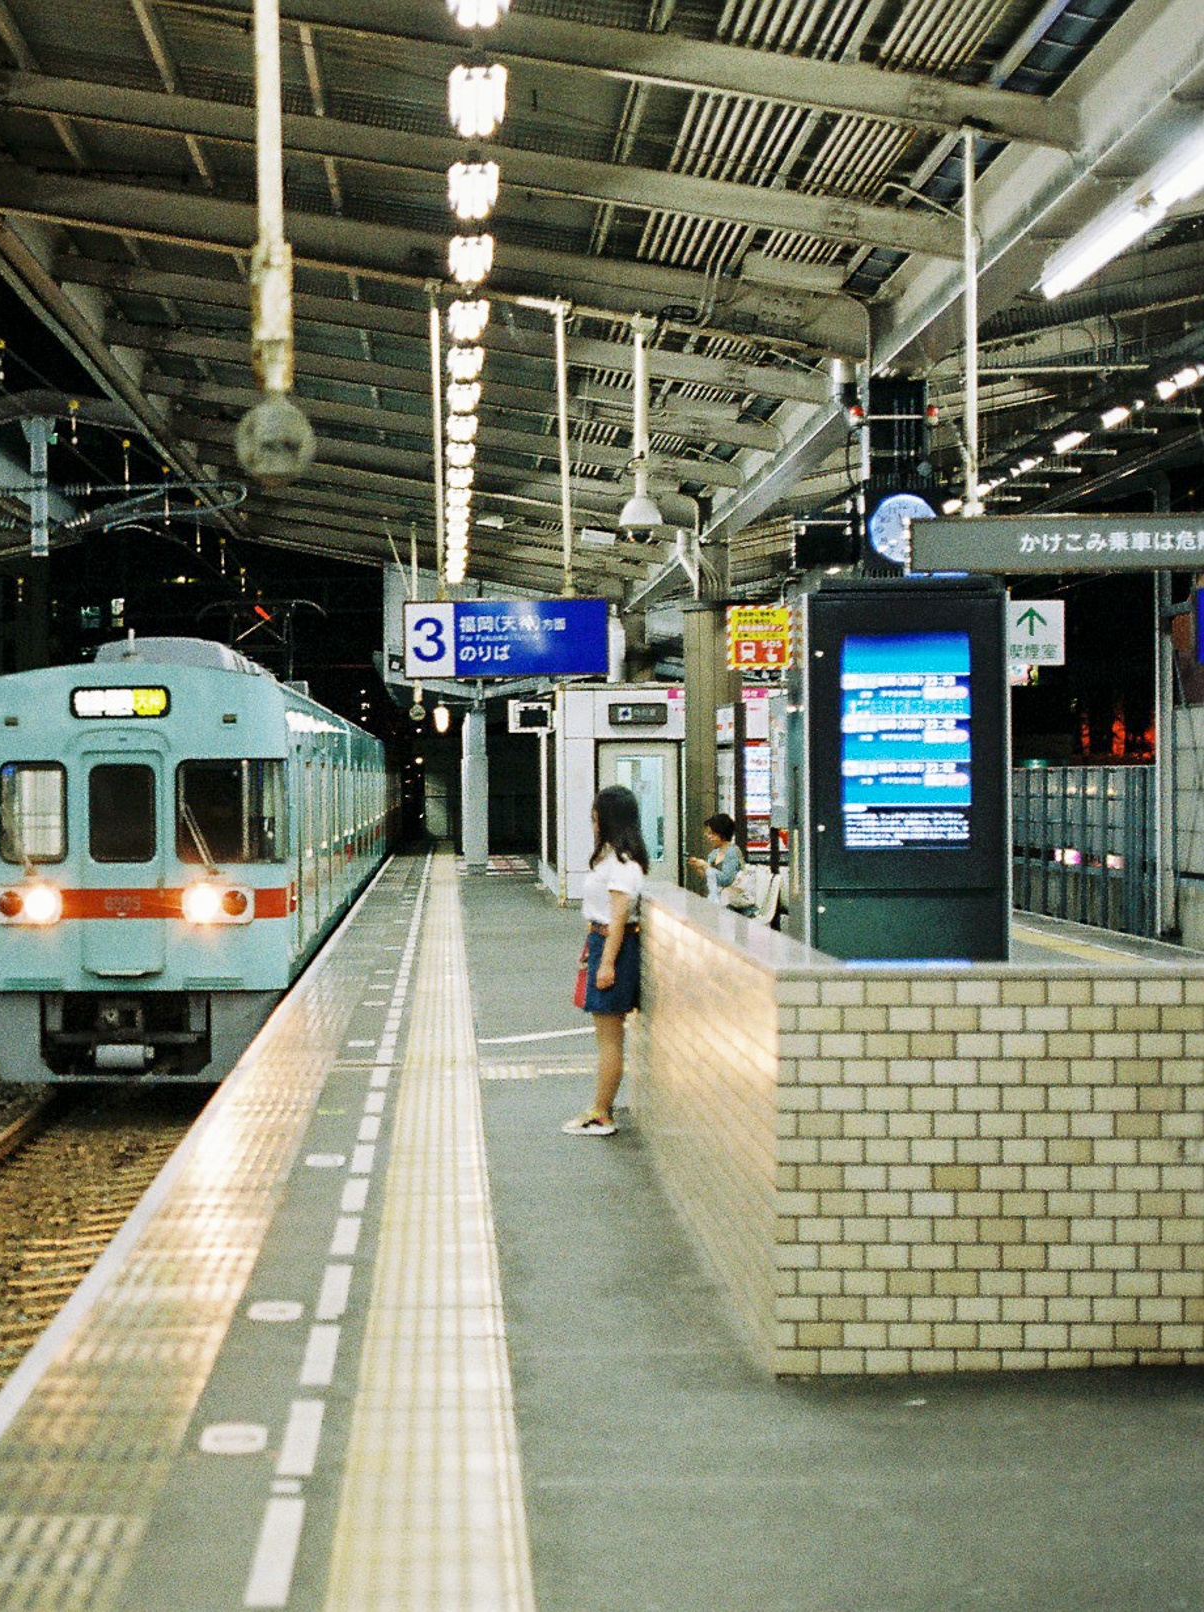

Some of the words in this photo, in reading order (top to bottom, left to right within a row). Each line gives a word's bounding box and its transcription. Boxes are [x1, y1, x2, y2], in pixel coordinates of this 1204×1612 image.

[412, 617, 446, 662] 3
[459, 645, 511, 662] のりば
